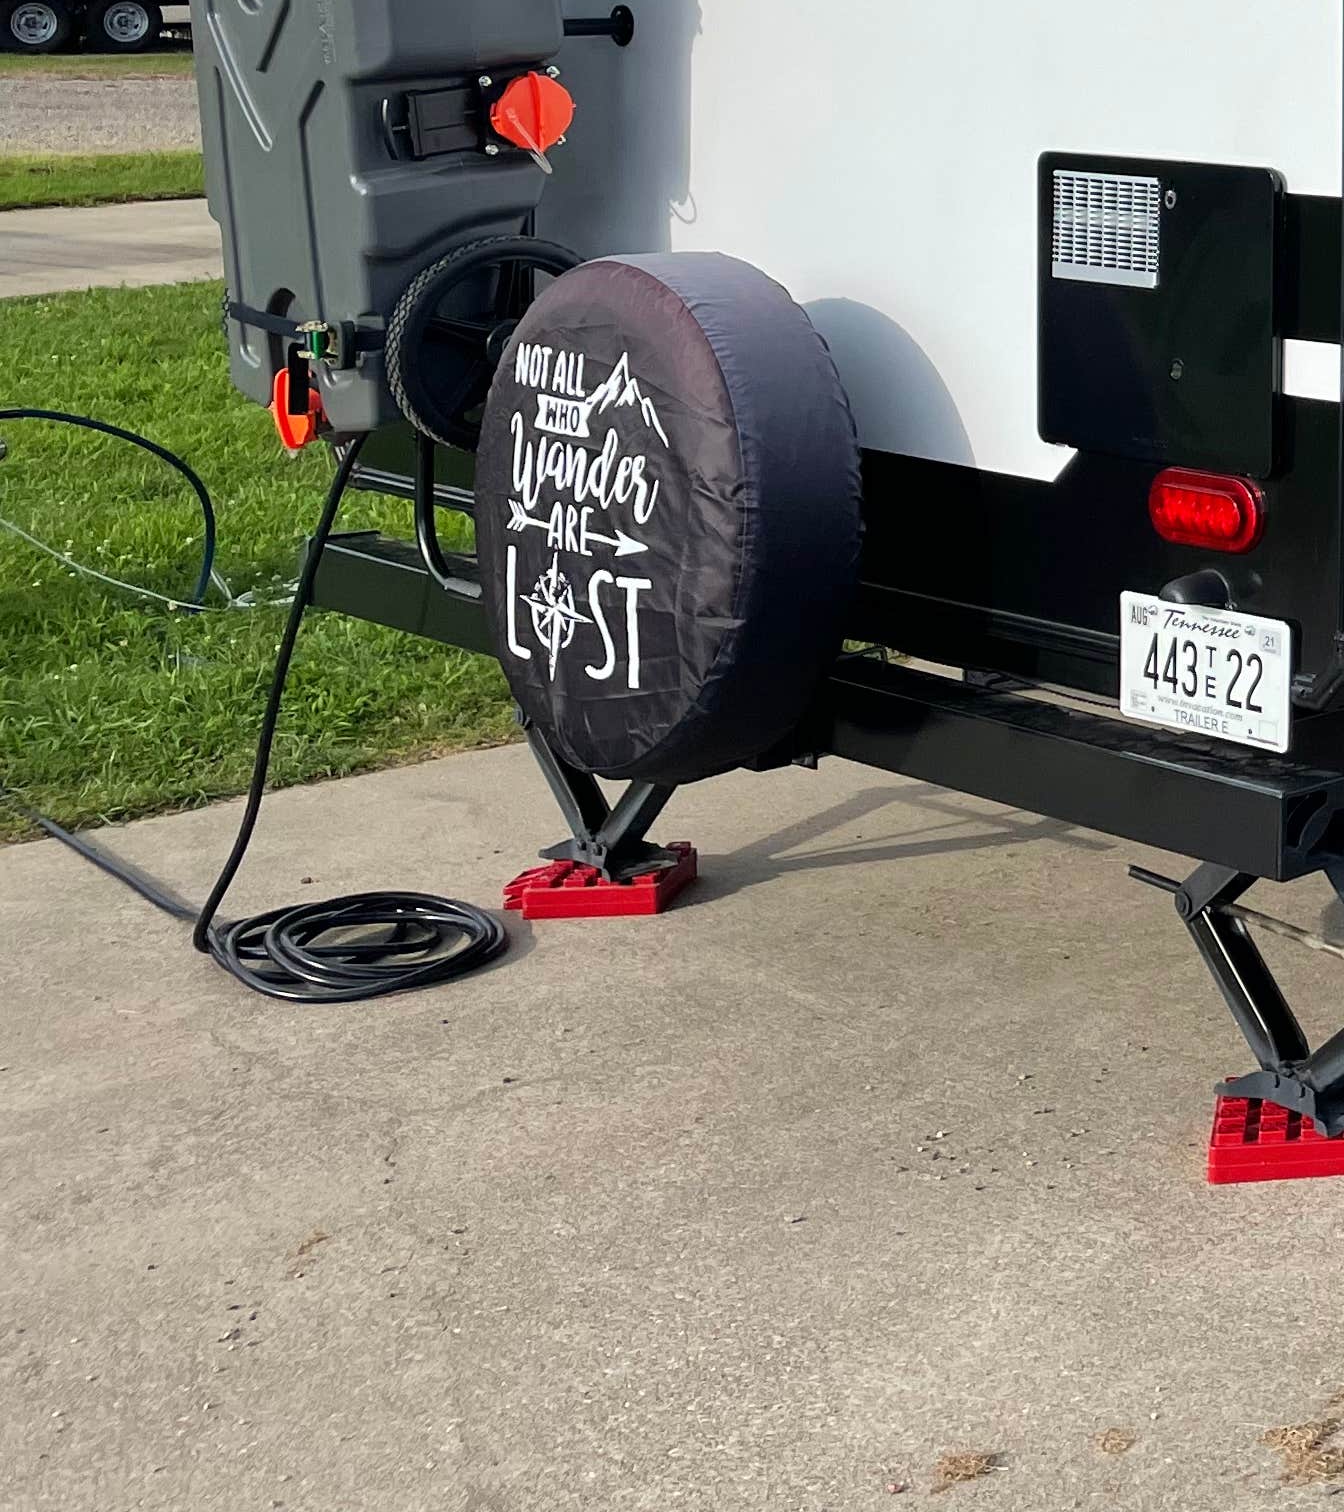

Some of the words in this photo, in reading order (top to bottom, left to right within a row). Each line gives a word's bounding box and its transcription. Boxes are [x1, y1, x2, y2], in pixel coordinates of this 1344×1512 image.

[515, 342, 553, 389] NOT
[552, 350, 586, 397] ALL
[545, 399, 580, 433] WHO
[511, 411, 659, 525] Wander
[547, 501, 594, 556] ARE
[1131, 605, 1148, 625] AUG
[1163, 609, 1242, 639] Tennessee
[1263, 635, 1275, 648] 21
[1143, 632, 1198, 698] 443
[1226, 648, 1263, 714] 22
[1173, 709, 1220, 731] TRAILER
